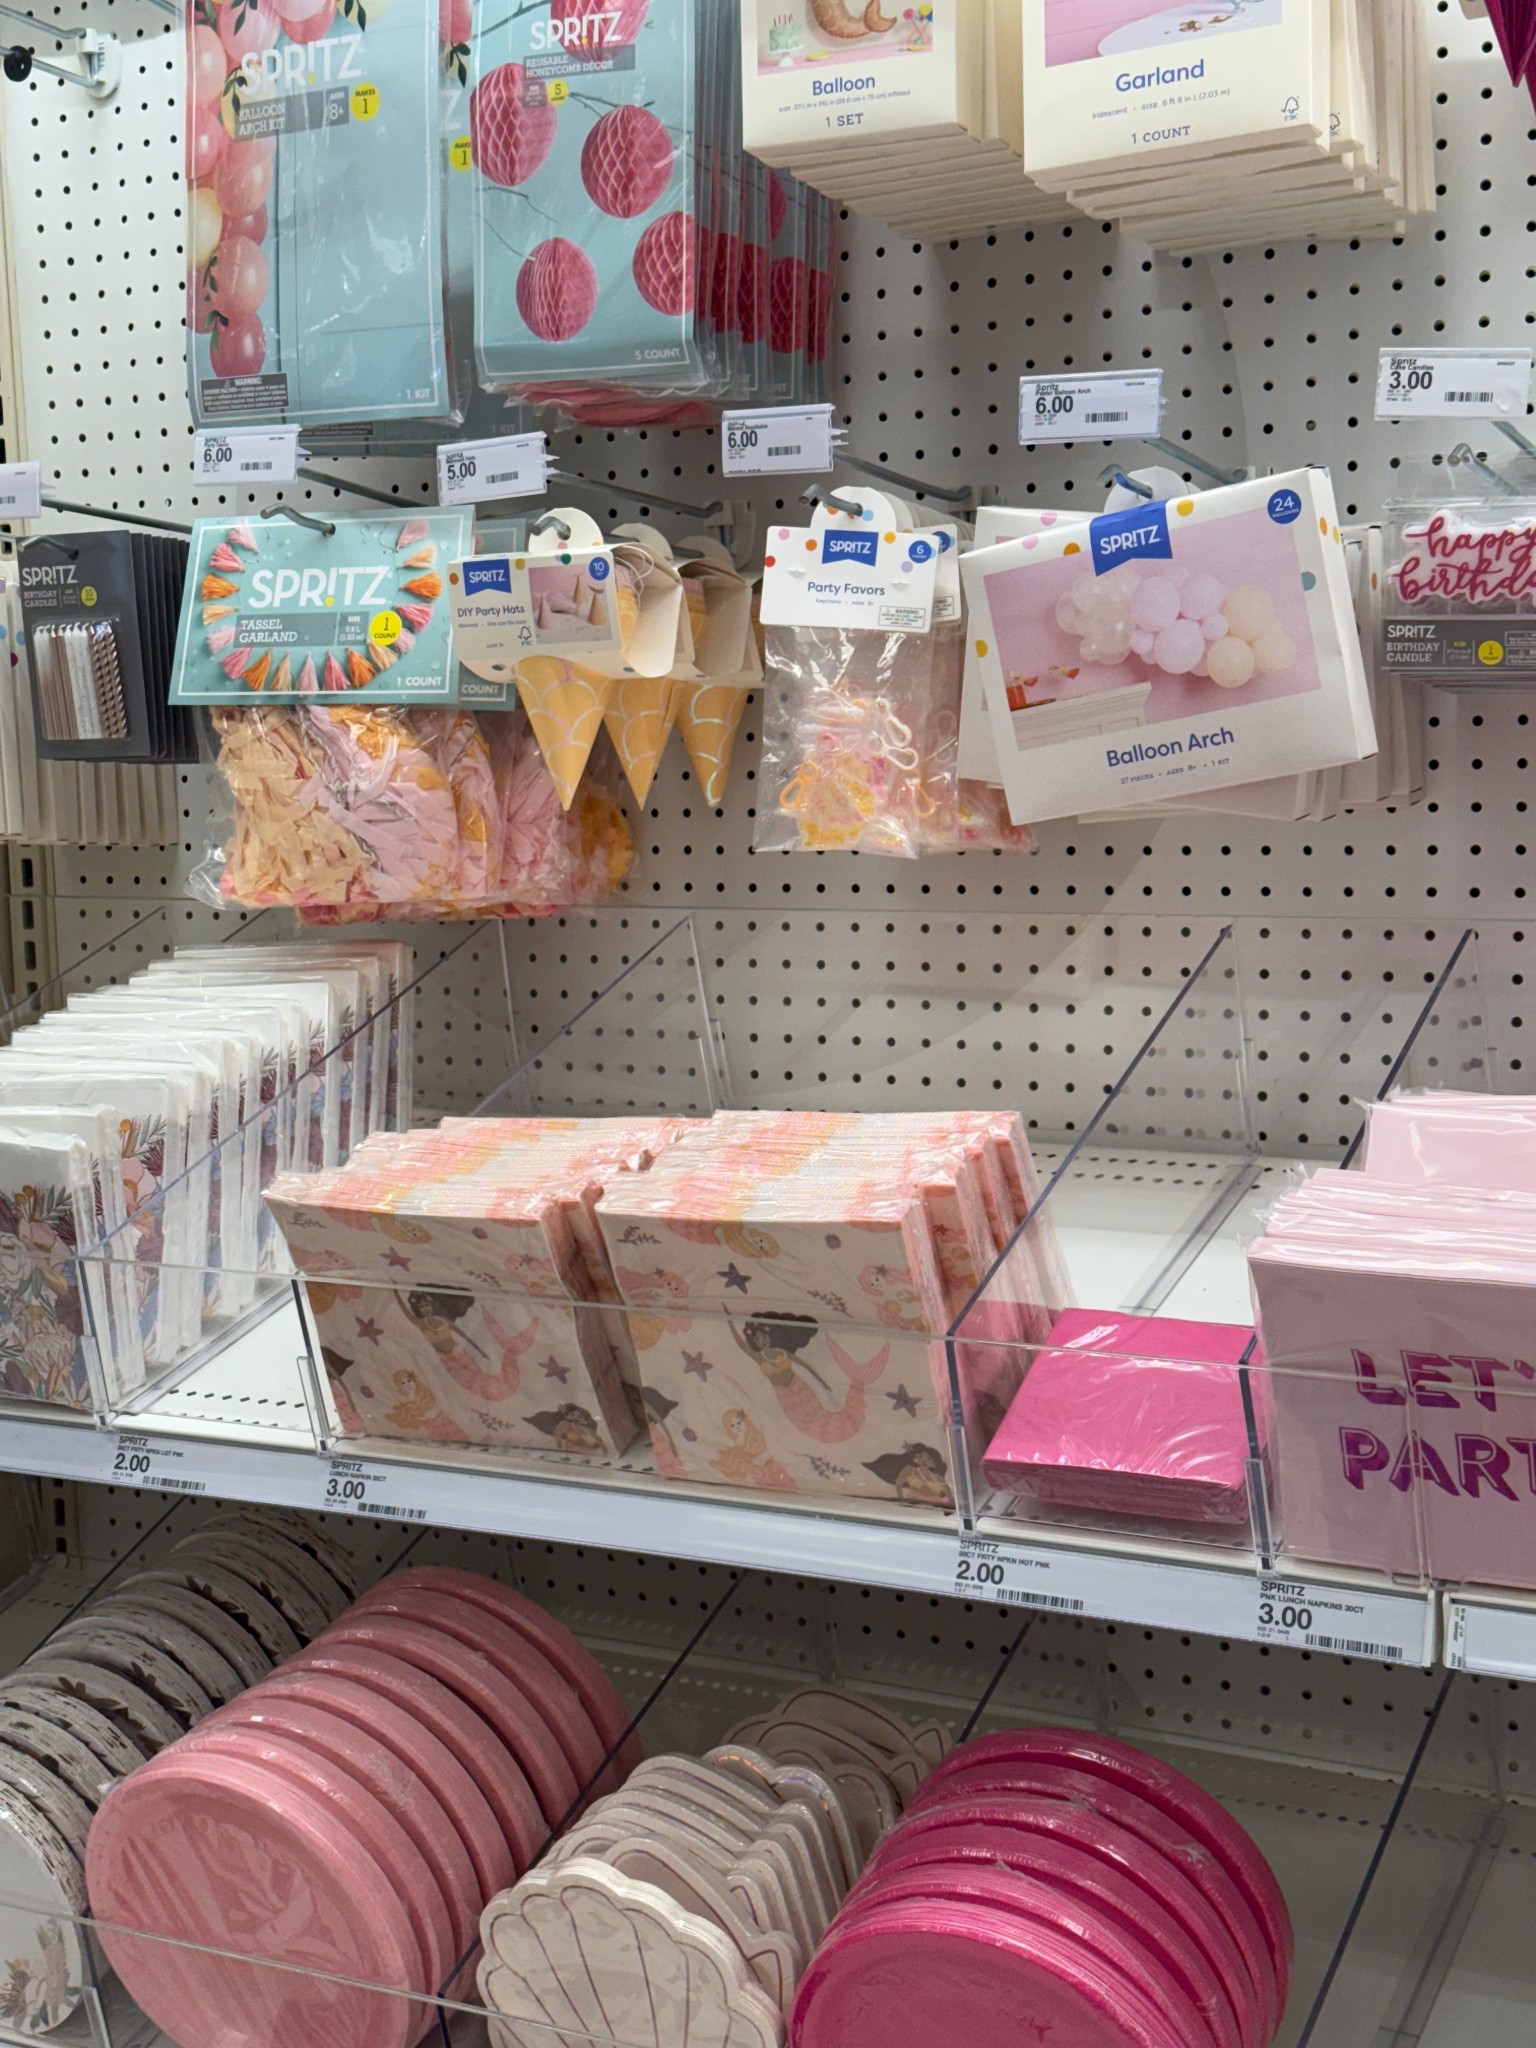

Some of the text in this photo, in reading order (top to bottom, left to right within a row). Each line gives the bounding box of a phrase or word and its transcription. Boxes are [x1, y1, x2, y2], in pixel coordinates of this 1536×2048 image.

[526, 55, 568, 68] REUSABLE
[526, 60, 614, 78] HONEYCOMB DÉCOR
[1115, 59, 1205, 92] Garland
[355, 88, 376, 97] MAKES
[555, 84, 562, 95] 5
[812, 76, 876, 96] Balloon
[240, 102, 286, 122] BALLOON
[329, 103, 345, 120] 8+
[362, 98, 369, 114] 1
[1092, 107, 1128, 119] Iridescent
[239, 118, 286, 135] ARCH KIT
[825, 113, 864, 127] 1 SET
[1131, 126, 1191, 144] 1 COUNT
[635, 347, 681, 361] 5 COUNT
[1388, 370, 1433, 390] 3.00
[414, 387, 430, 400] KIT
[1035, 395, 1074, 414] 6.00
[727, 430, 758, 448] 6.00
[203, 447, 232, 463] 6.00
[447, 461, 476, 480] 5.00
[1273, 495, 1295, 512] 24
[1405, 516, 1536, 563] happy
[916, 545, 925, 555] 6
[593, 561, 605, 572] 10
[807, 581, 885, 596] Party Favors
[24, 598, 57, 608] CANDLES
[457, 605, 525, 617] DIY Party Hats
[240, 619, 283, 631] TASSEL
[384, 617, 389, 631] 1
[239, 631, 297, 644] GARLAND
[374, 632, 397, 640] COUNT
[1386, 642, 1440, 652] BIRTHDAY
[1488, 645, 1493, 655] 1
[1386, 652, 1432, 662] CANDLE
[396, 676, 443, 687] 1 COUNT
[461, 684, 500, 695] COUNT
[1106, 726, 1235, 768] Balloon Arch
[1130, 774, 1154, 783] PIECES
[1166, 767, 1184, 776] AGES
[118, 1435, 149, 1447] SPRITZ
[130, 1446, 145, 1454] PRTY
[113, 1452, 150, 1473] 2.00
[331, 1460, 363, 1472] SPRITZ
[350, 1473, 371, 1481] NAPKIN
[326, 1478, 365, 1499] 3.00
[959, 1540, 1000, 1554] SPRITZ
[958, 1550, 1051, 1569] 30CT PRTY NPKN HOT PNK
[956, 1560, 1004, 1585] 2.00
[1260, 1581, 1306, 1597] SPRITZ
[1260, 1592, 1365, 1614] PNK LUNCH NAPKINS 30CT
[1258, 1602, 1312, 1630] 3.00
